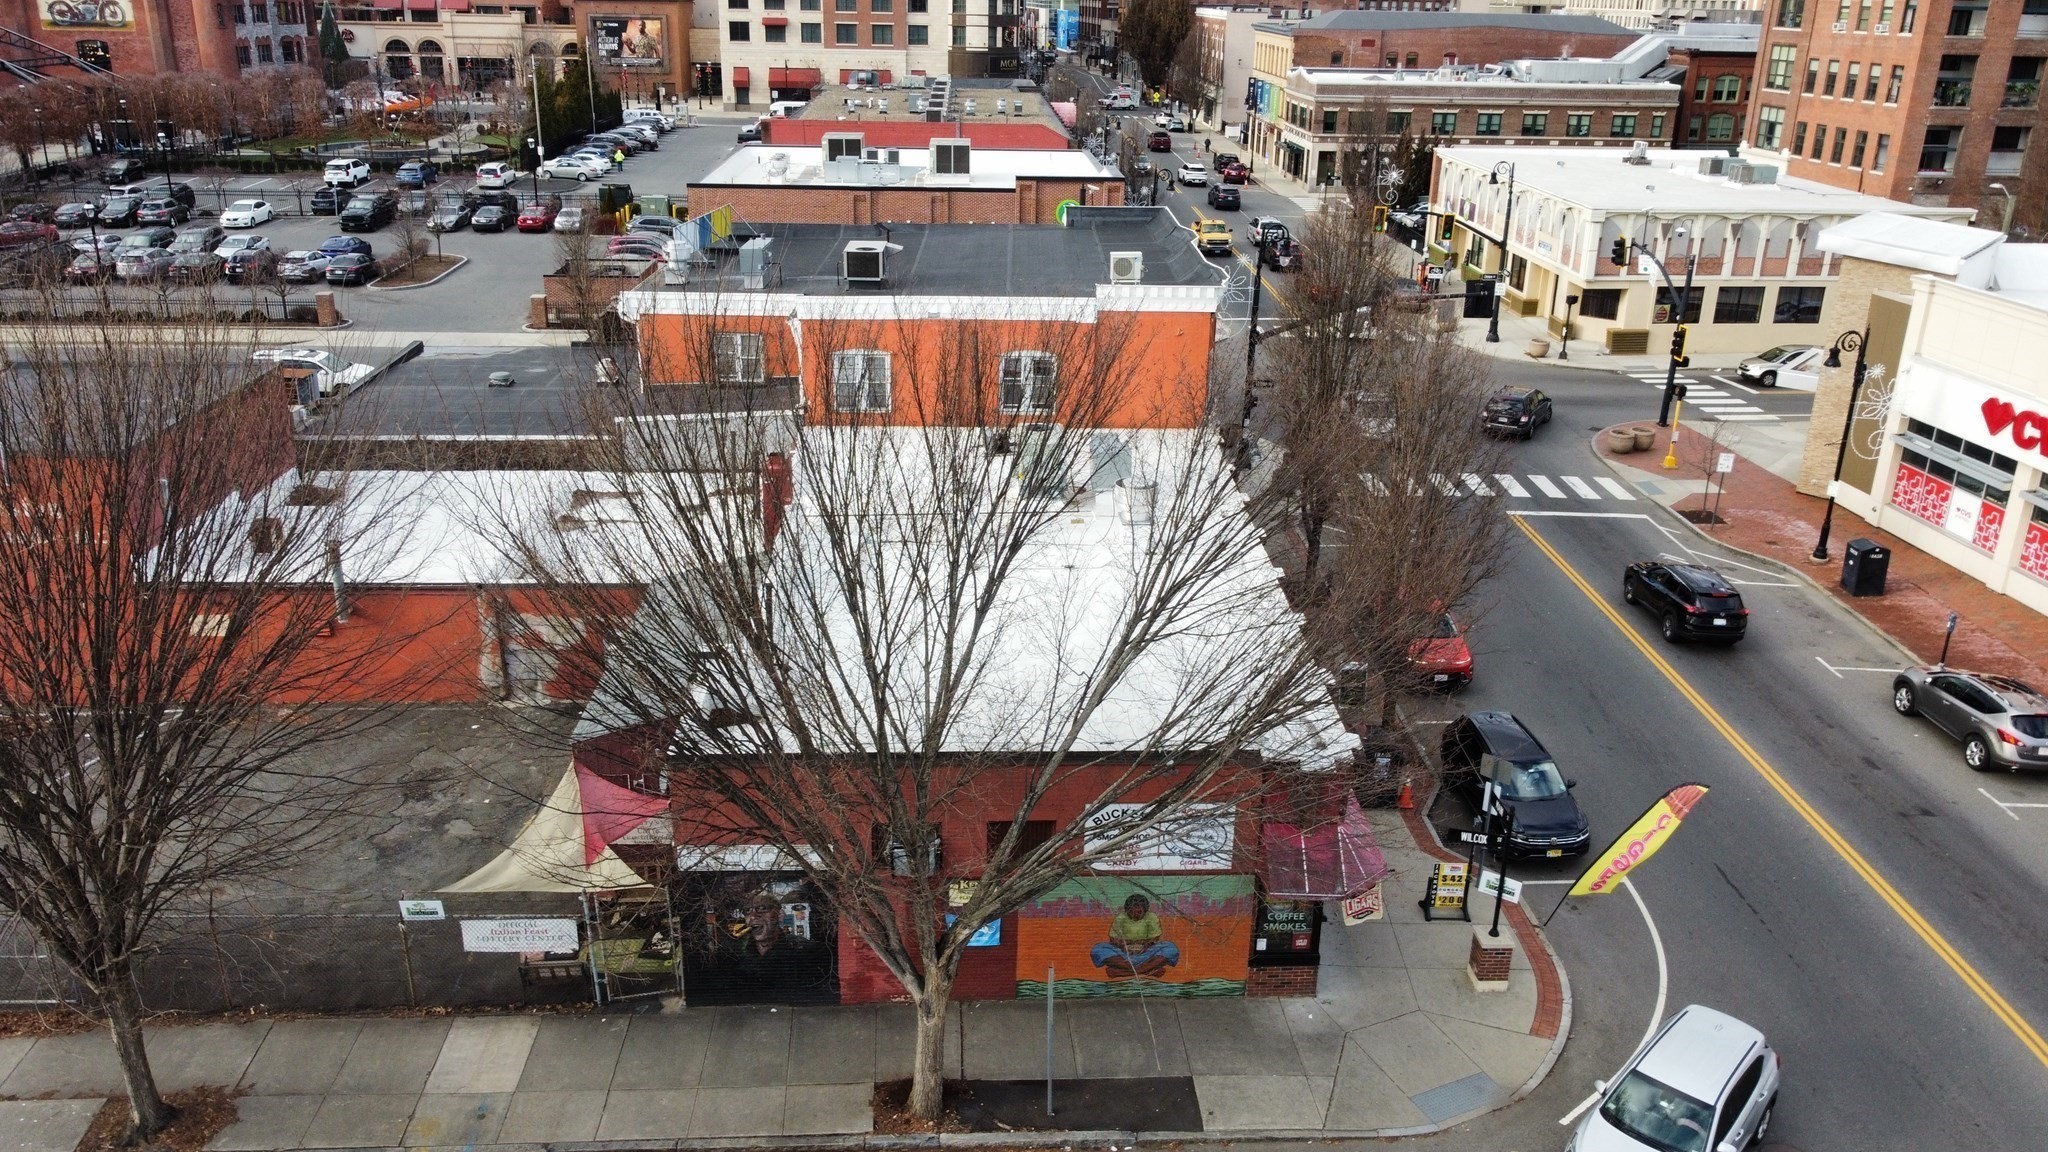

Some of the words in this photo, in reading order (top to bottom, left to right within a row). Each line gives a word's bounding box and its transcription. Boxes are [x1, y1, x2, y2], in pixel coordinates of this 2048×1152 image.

[1000, 59, 1017, 68] MGM
[2012, 410, 2048, 458] C
[1460, 831, 1488, 844] WILCOX
[1589, 813, 1672, 892] CIGARS
[1267, 912, 1305, 920] COFFEE
[1263, 922, 1307, 931] SMOKES
[490, 928, 522, 936] Italian
[524, 928, 550, 936] Feast
